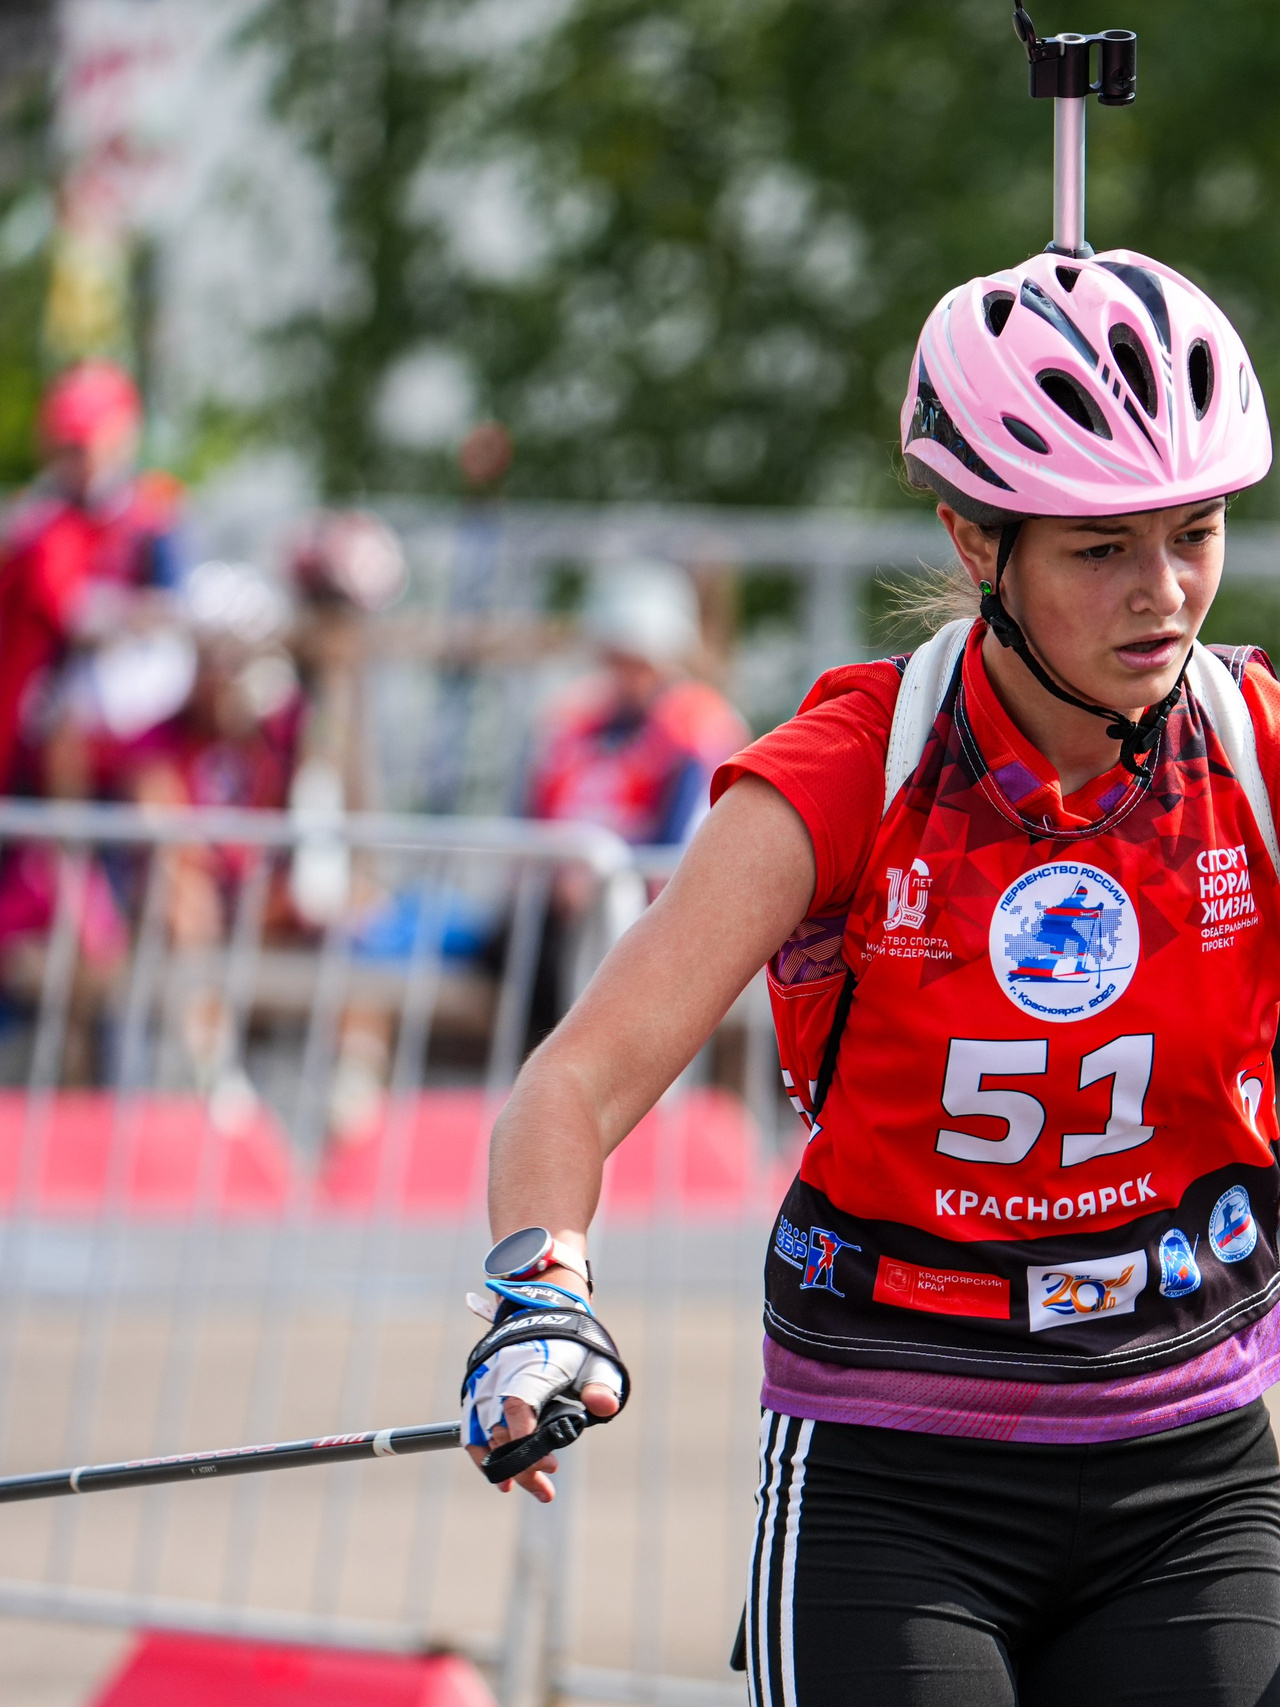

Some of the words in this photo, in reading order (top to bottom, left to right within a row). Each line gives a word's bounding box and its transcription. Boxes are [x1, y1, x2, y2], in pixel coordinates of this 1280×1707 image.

[1196, 844, 1248, 873] СПОРТ
[912, 878, 933, 888] ЛЕТ
[1000, 865, 1079, 911] ПЕРВЕНСТВО
[1080, 868, 1126, 906] РОССИИ
[1201, 914, 1259, 939] ФЕДЕРАЛЬНЫЙ
[888, 948, 953, 960] ФЕДЕРАЦИИ
[910, 937, 949, 948] СПОРТА
[1202, 936, 1235, 953] ПРОЕКТ
[1018, 991, 1085, 1017] Красноярск
[1088, 983, 1117, 1008] 2023
[934, 1033, 1155, 1168] 51
[935, 1172, 1158, 1221] КРАСНОЯРСК
[917, 1280, 945, 1292] КРАЙ
